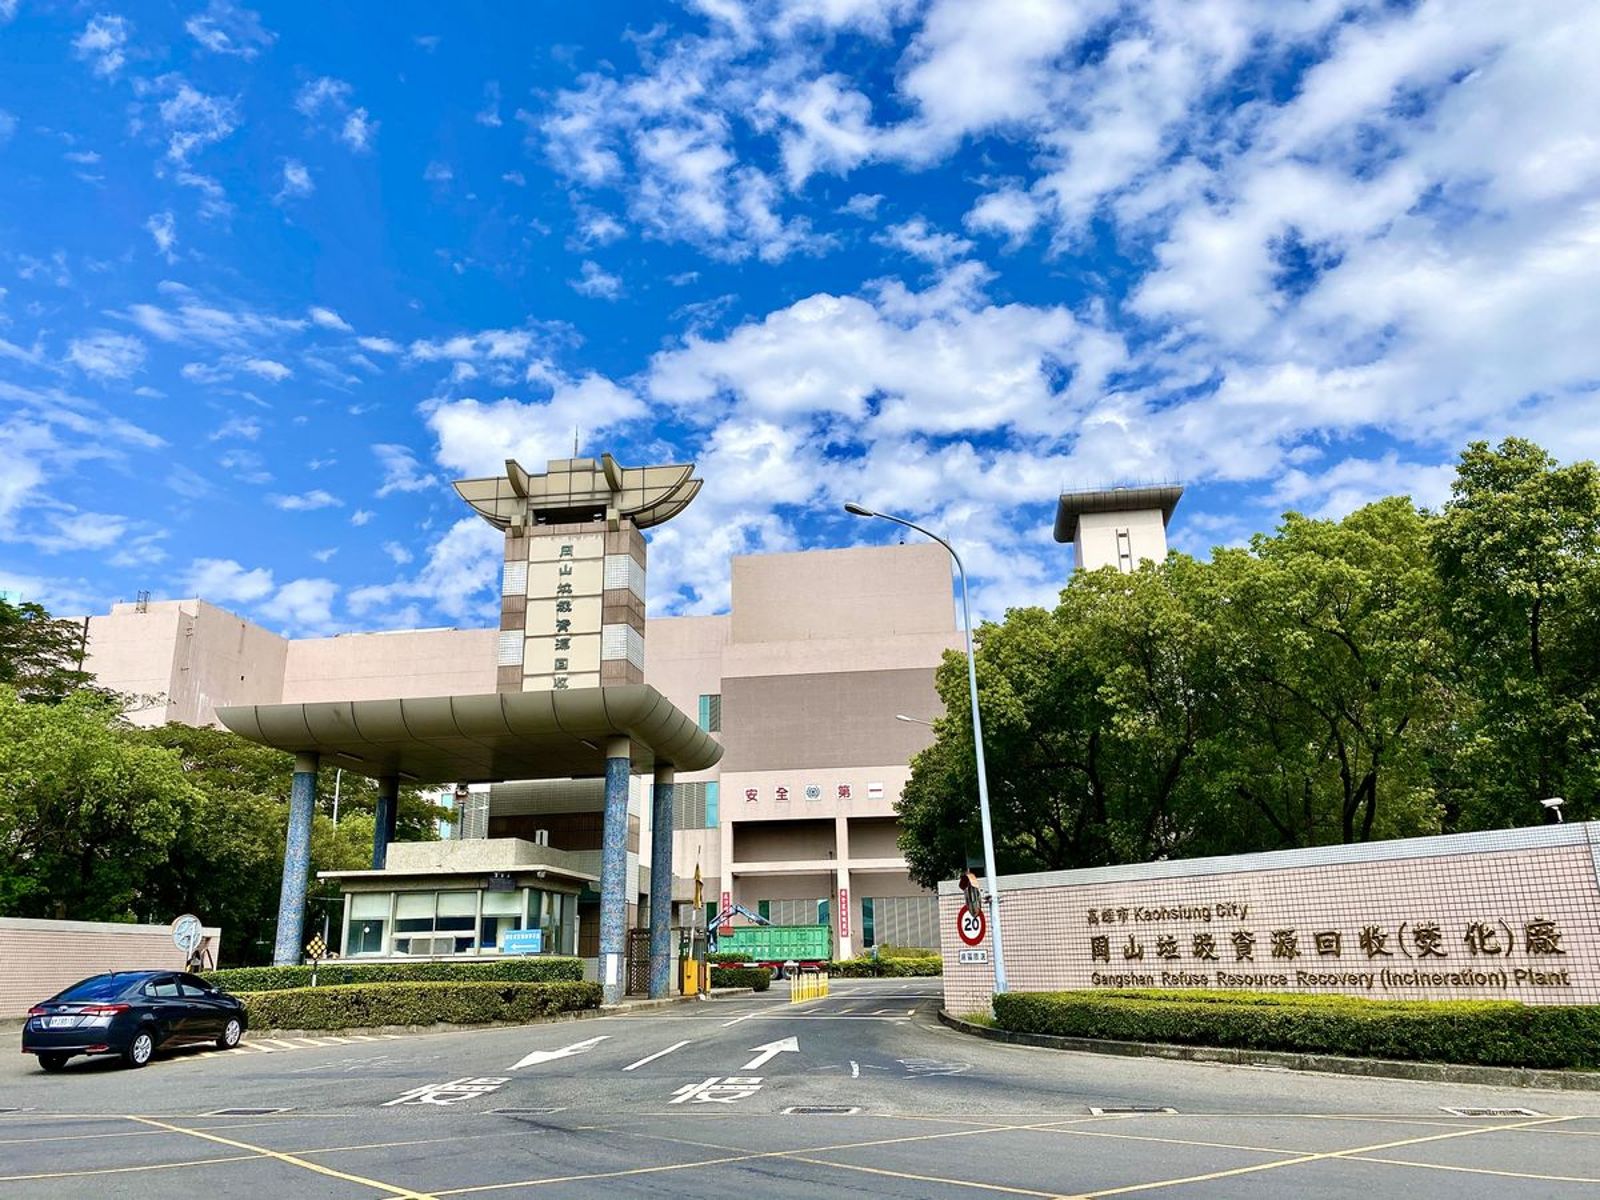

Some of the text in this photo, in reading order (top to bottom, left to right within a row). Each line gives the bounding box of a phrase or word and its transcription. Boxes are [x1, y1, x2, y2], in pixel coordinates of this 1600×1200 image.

[964, 917, 979, 931] 20
[1087, 901, 1249, 925] 高雄市 Kaohsiung City
[1091, 967, 1571, 989] Gangshan Refuse Resource Recovery (Incineration) Plant
[380, 1076, 513, 1106] 慢
[667, 1077, 765, 1104] 慢
